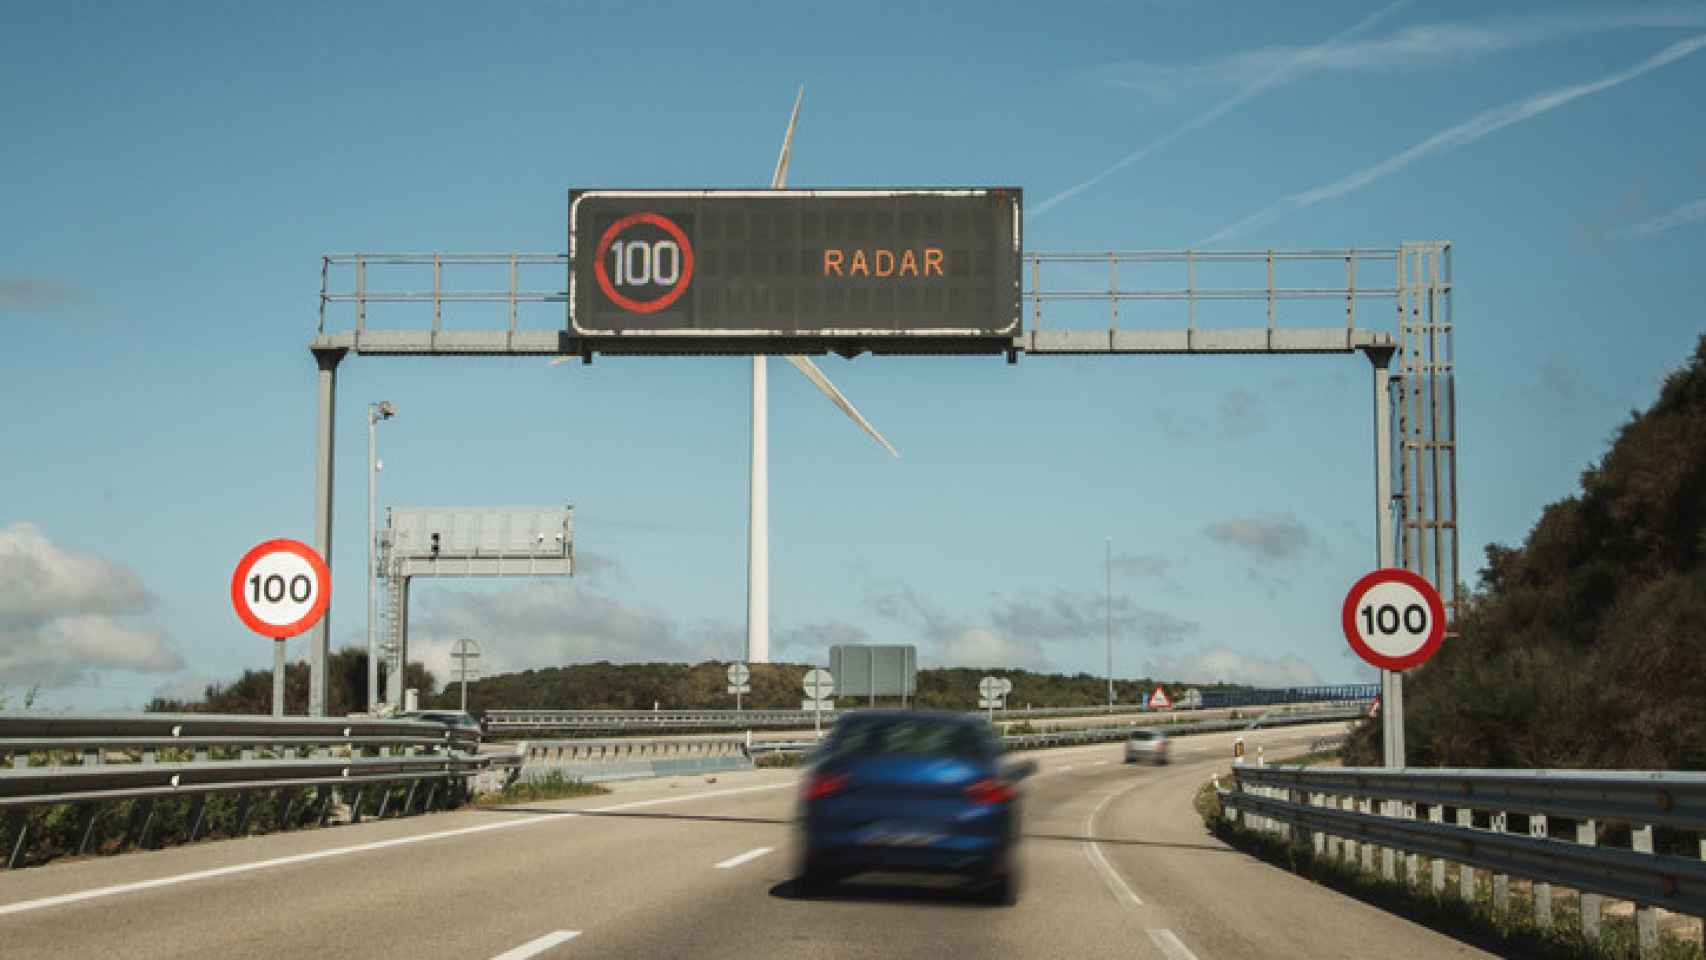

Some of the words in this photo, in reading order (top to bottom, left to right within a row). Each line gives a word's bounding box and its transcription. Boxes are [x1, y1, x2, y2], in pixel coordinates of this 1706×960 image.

[611, 240, 680, 287] 100
[823, 247, 945, 277] RADAR
[249, 573, 312, 604] 100
[1361, 604, 1427, 635] 100
